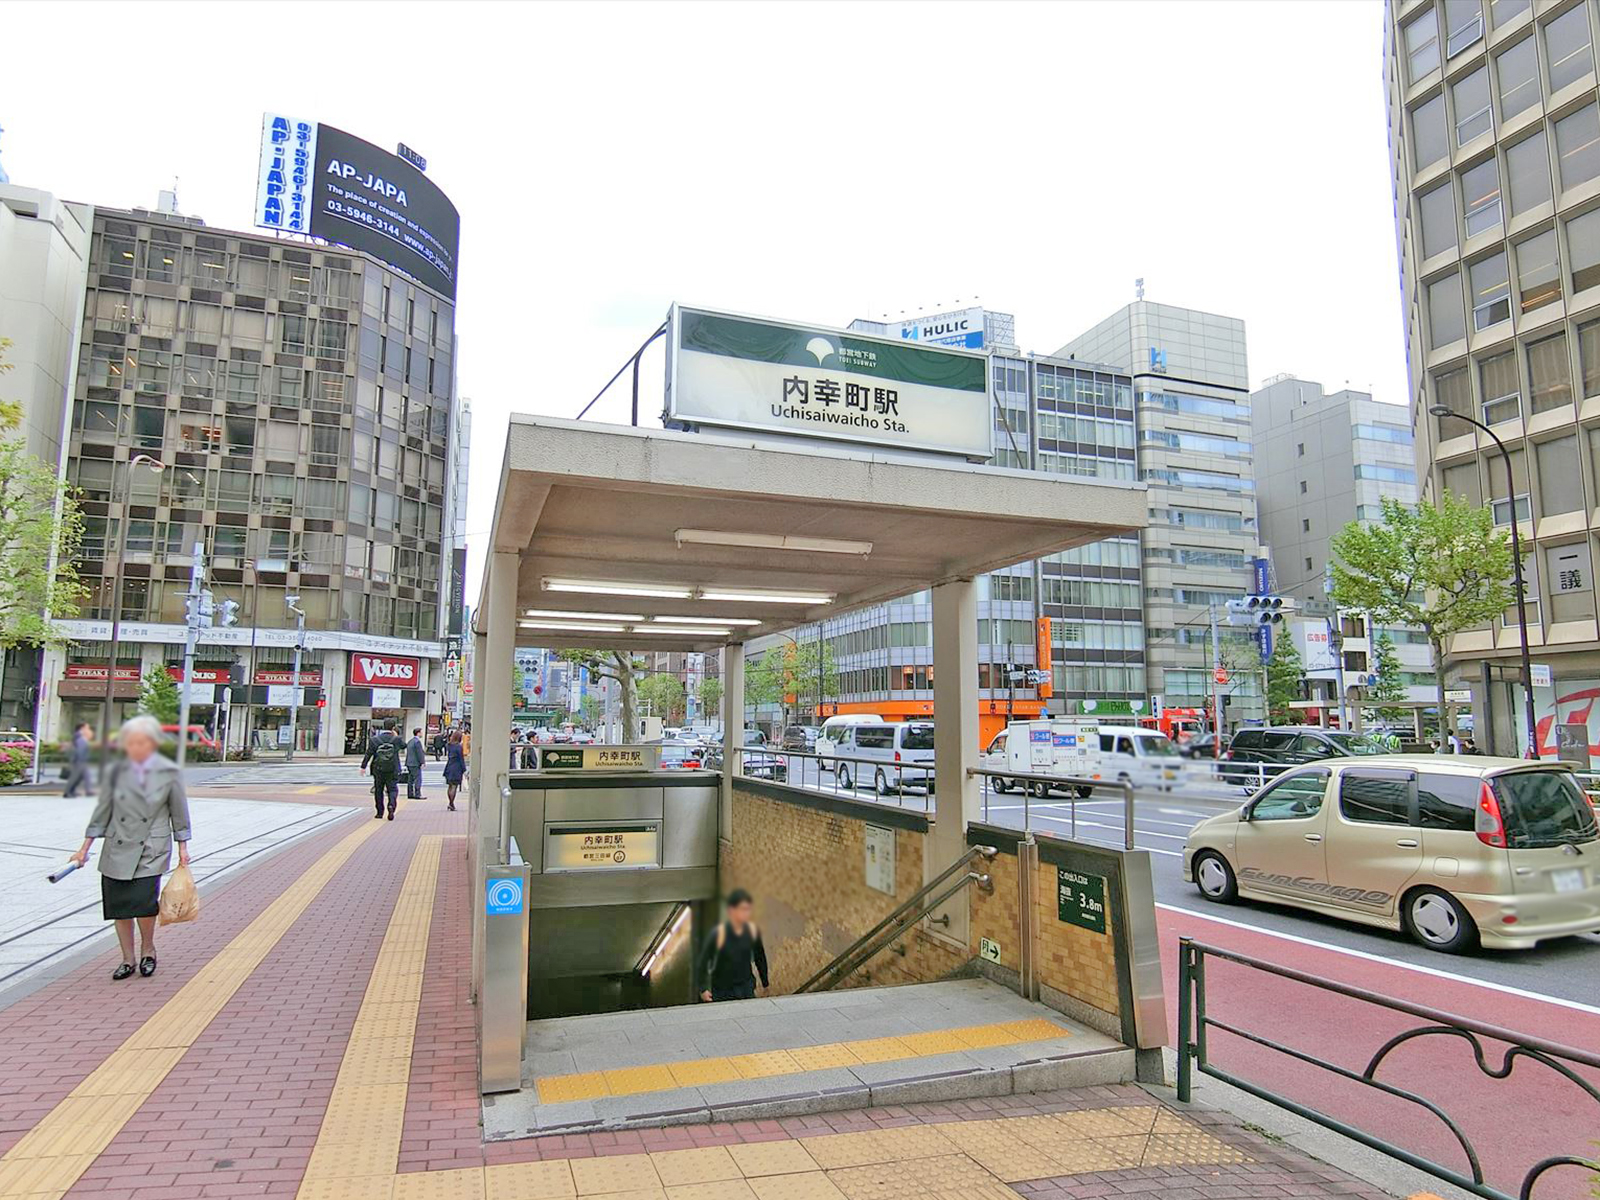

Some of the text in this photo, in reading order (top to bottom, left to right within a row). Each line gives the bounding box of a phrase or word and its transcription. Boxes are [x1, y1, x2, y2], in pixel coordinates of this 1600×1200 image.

[264, 116, 291, 226] AP-JAPAN
[326, 158, 408, 208] AP-JAPA
[327, 183, 344, 196] The
[344, 190, 368, 206] place
[368, 200, 378, 209] of
[378, 204, 407, 224] creation
[327, 199, 400, 237] 03-5946-3144
[923, 319, 968, 337] HULIC
[838, 347, 877, 361] 都営地下鉄
[853, 358, 877, 368] SUBWAY
[782, 375, 900, 417] 内幸町駅
[771, 403, 910, 433] Uchisaiwaicho Sta.
[359, 657, 414, 682] VOLKS
[599, 750, 641, 761] 内幸町駅
[584, 834, 624, 845] 内幸町駅
[1079, 892, 1103, 912] 3.8m
